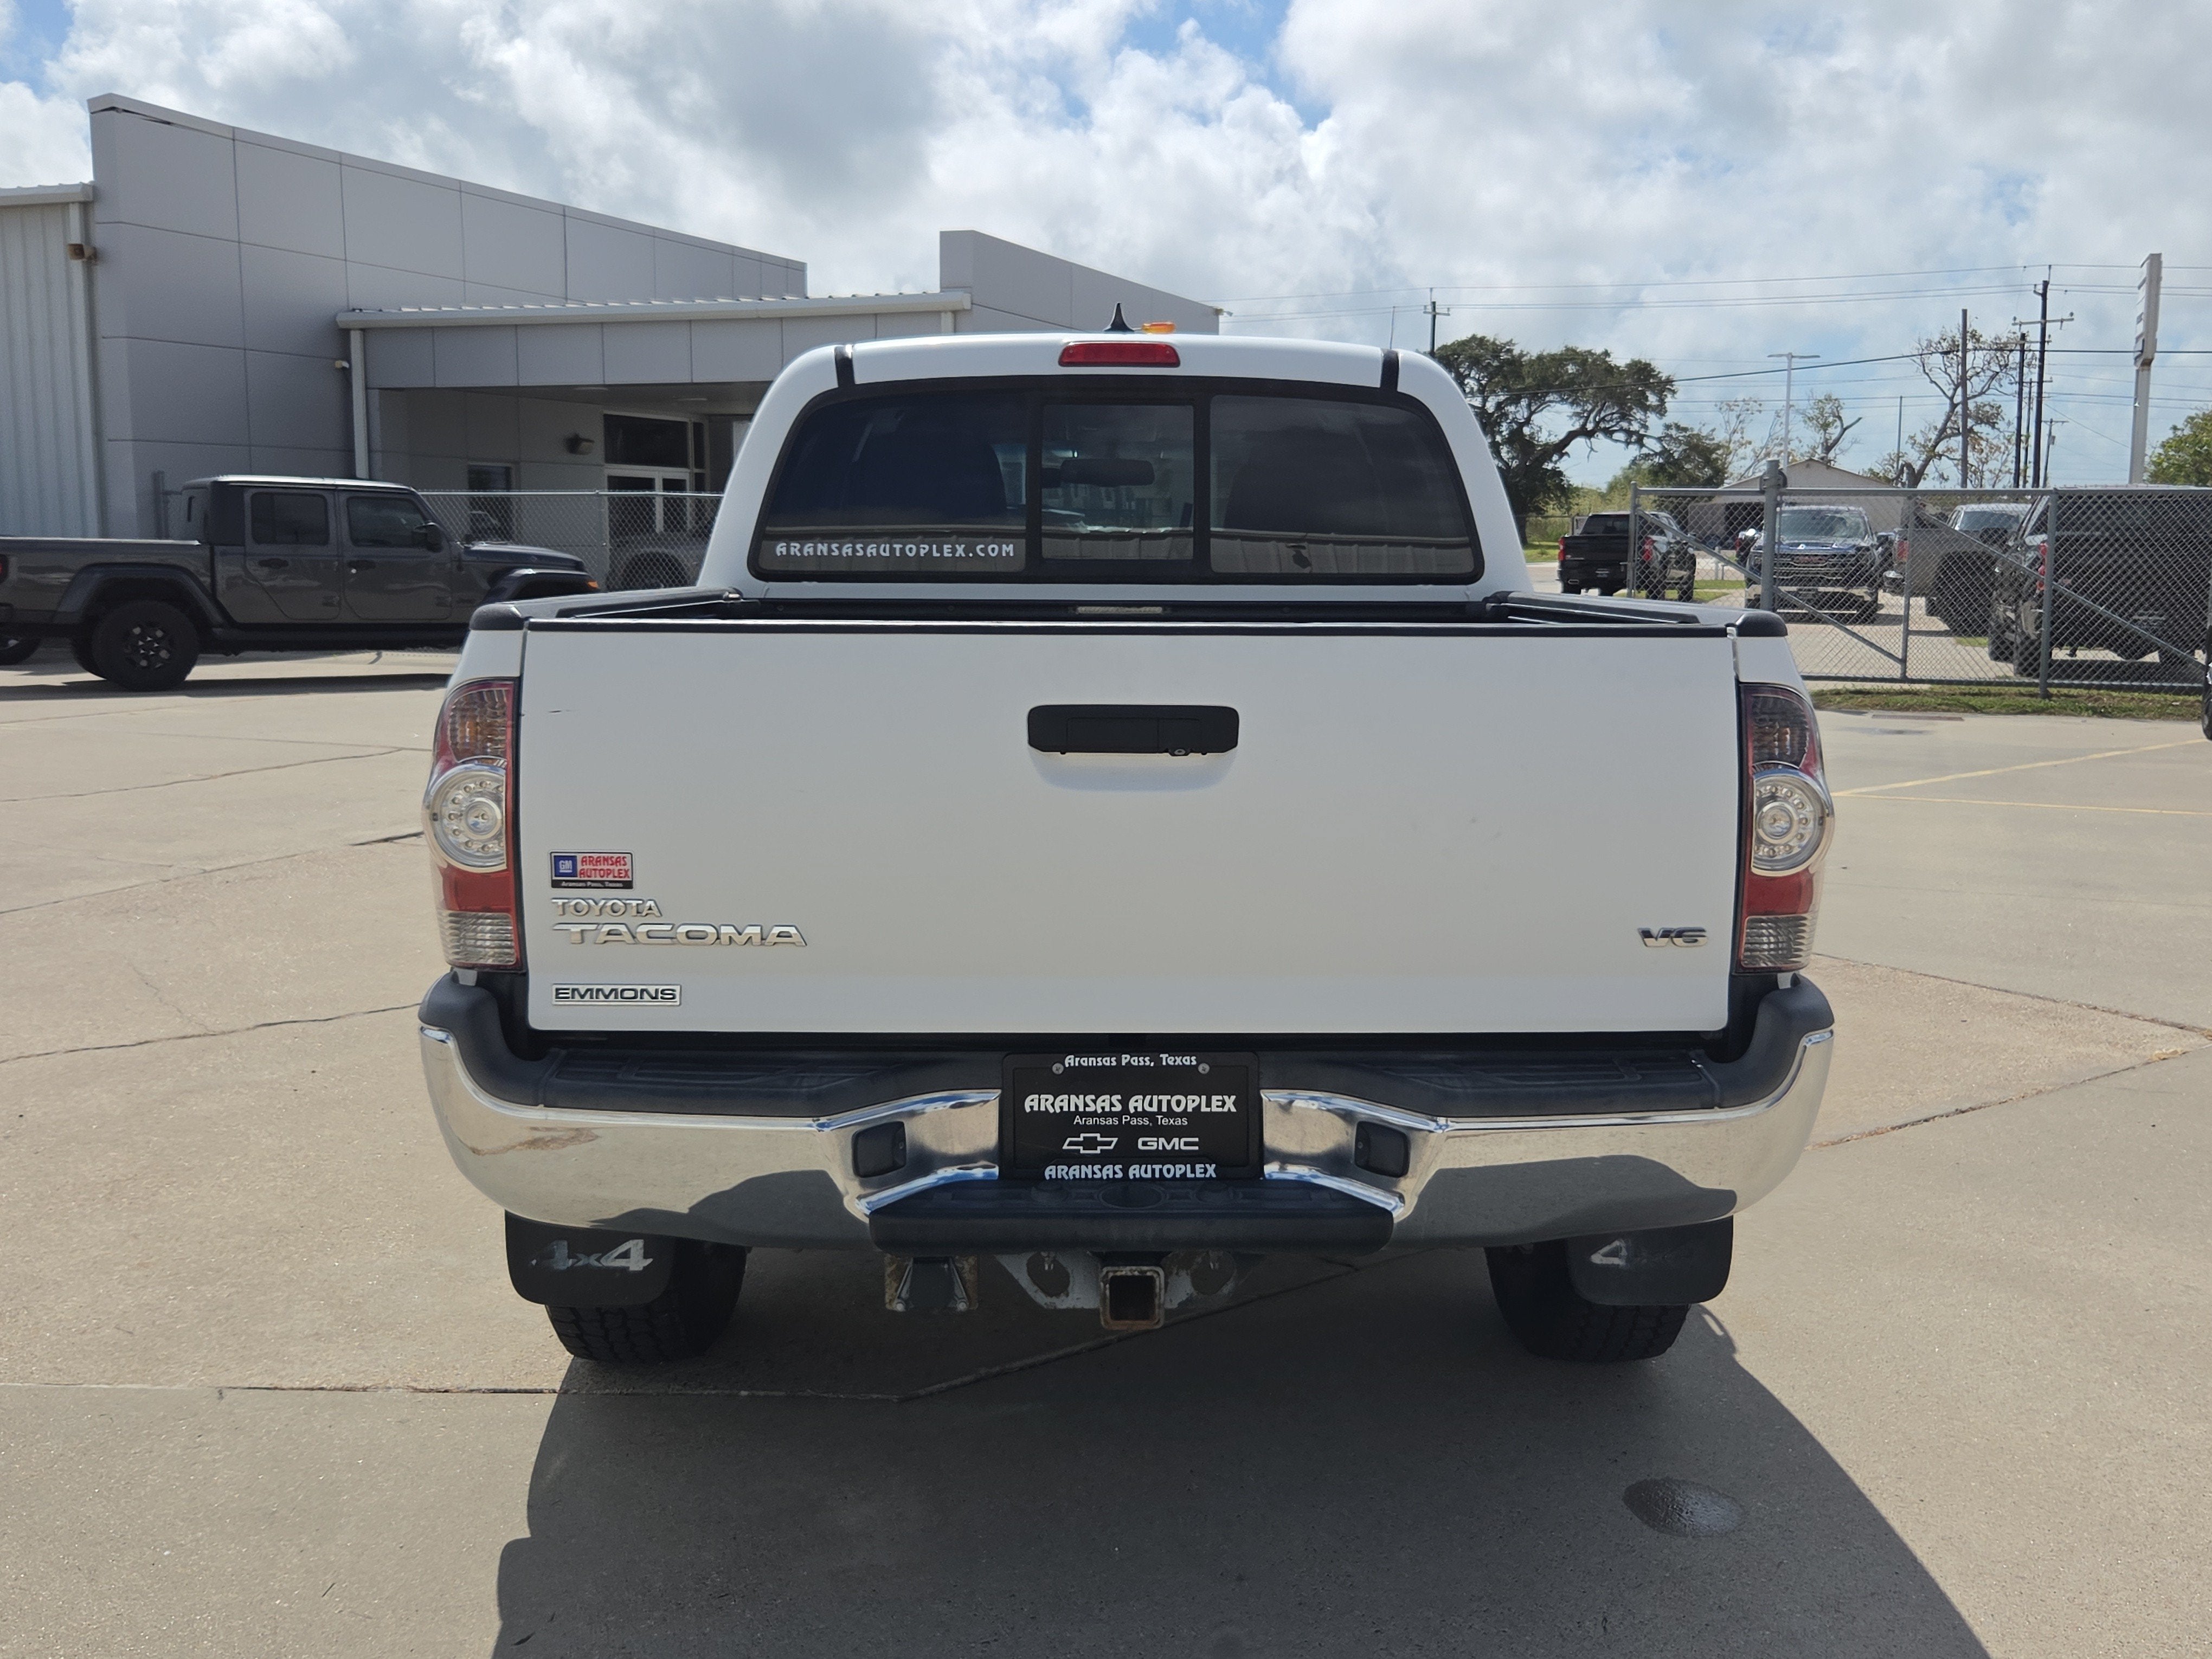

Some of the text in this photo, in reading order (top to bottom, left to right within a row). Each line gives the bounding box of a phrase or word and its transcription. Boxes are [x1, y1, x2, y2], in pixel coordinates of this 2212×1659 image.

[775, 543, 1014, 557] ARANSASAUTOPLEX.COM
[558, 860, 573, 871] GM
[581, 856, 627, 867] ARANSAS
[578, 868, 630, 878] AUTOPLEX
[551, 898, 663, 917] TOYOTA
[552, 923, 807, 947] TACOMA
[1637, 927, 1709, 948] V6
[554, 987, 677, 1000] EMMONS
[1064, 1053, 1197, 1068] Aransas Pass, Texas
[1024, 1094, 1237, 1114] ARANSAS AUTOPLEX
[1073, 1115, 1188, 1127] Aransas Pass, Texas
[1137, 1137, 1199, 1151] GMC
[1044, 1163, 1217, 1180] ARANSAS AUTOPLEX
